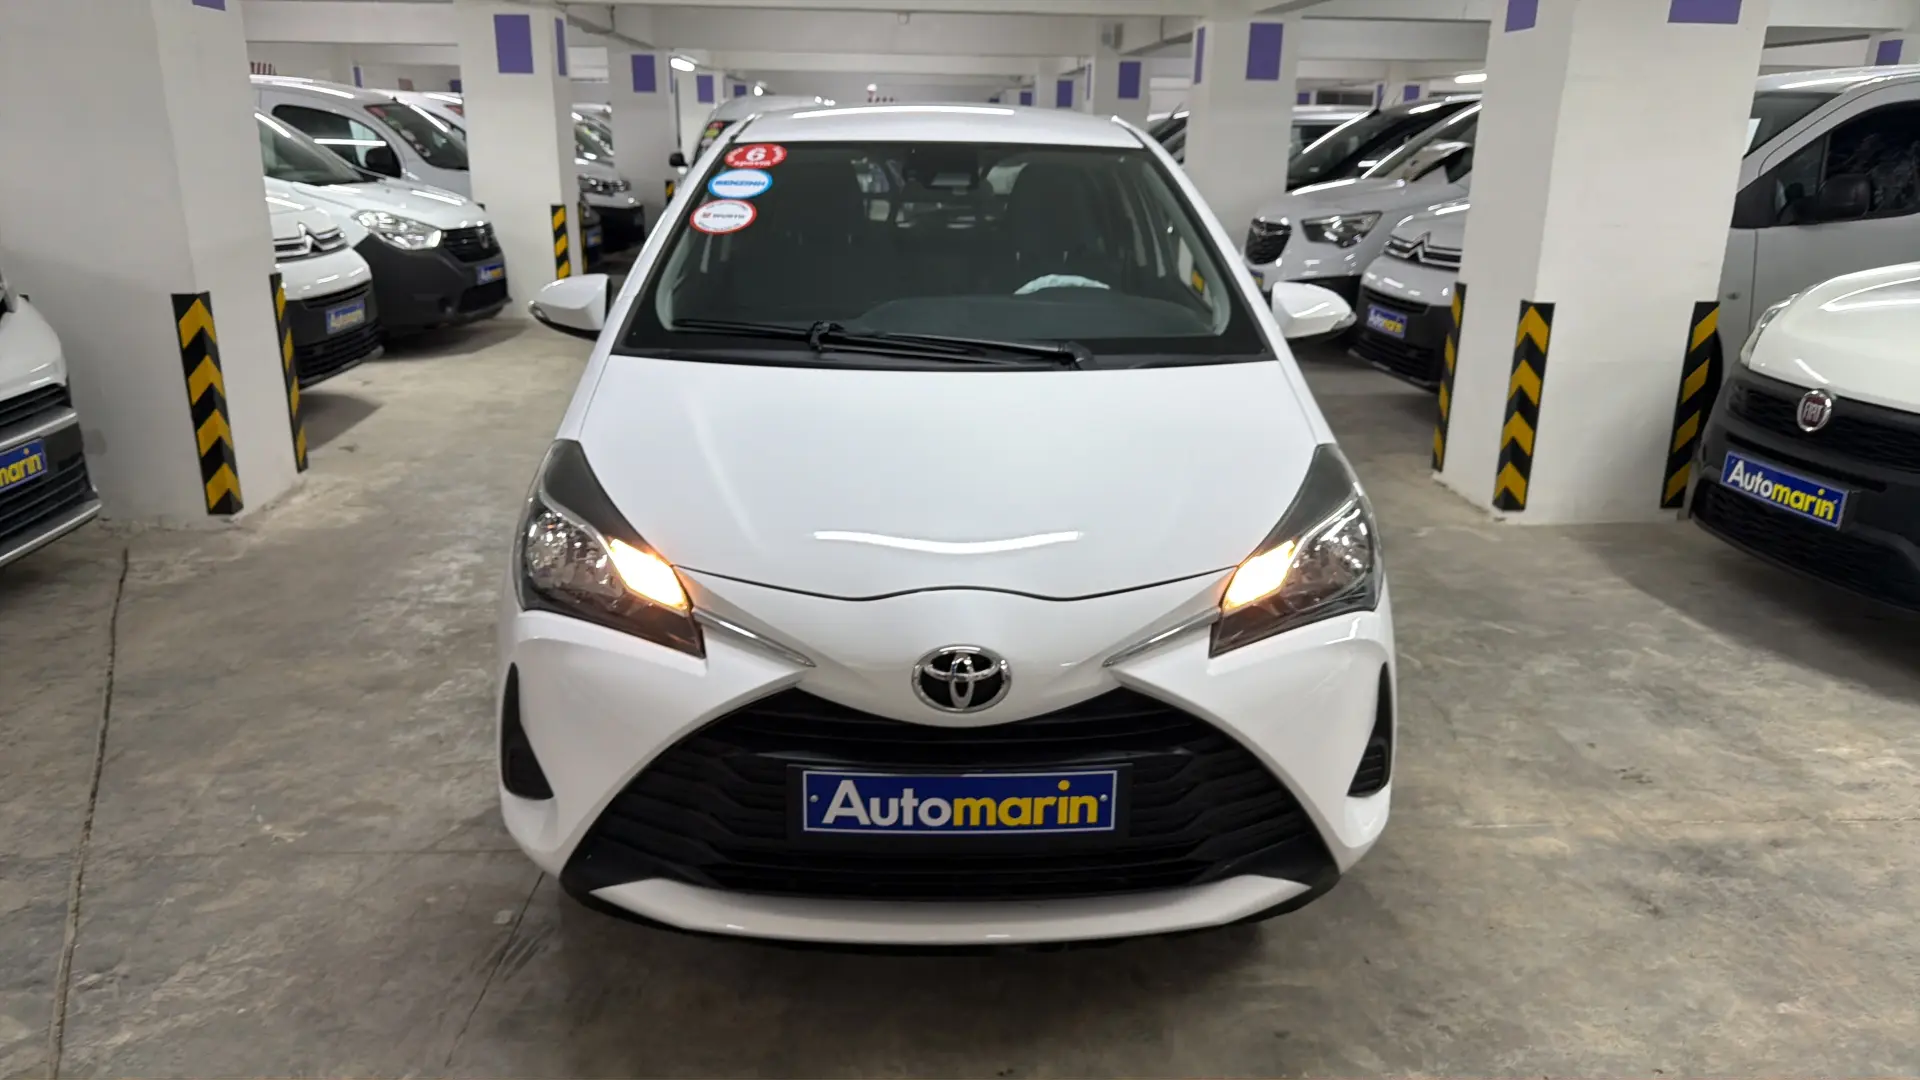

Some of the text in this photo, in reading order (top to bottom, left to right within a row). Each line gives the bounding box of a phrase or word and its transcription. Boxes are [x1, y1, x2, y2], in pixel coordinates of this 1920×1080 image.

[746, 147, 767, 162] 6
[1727, 460, 1836, 520] Automarin
[821, 779, 1098, 827] Automarin
